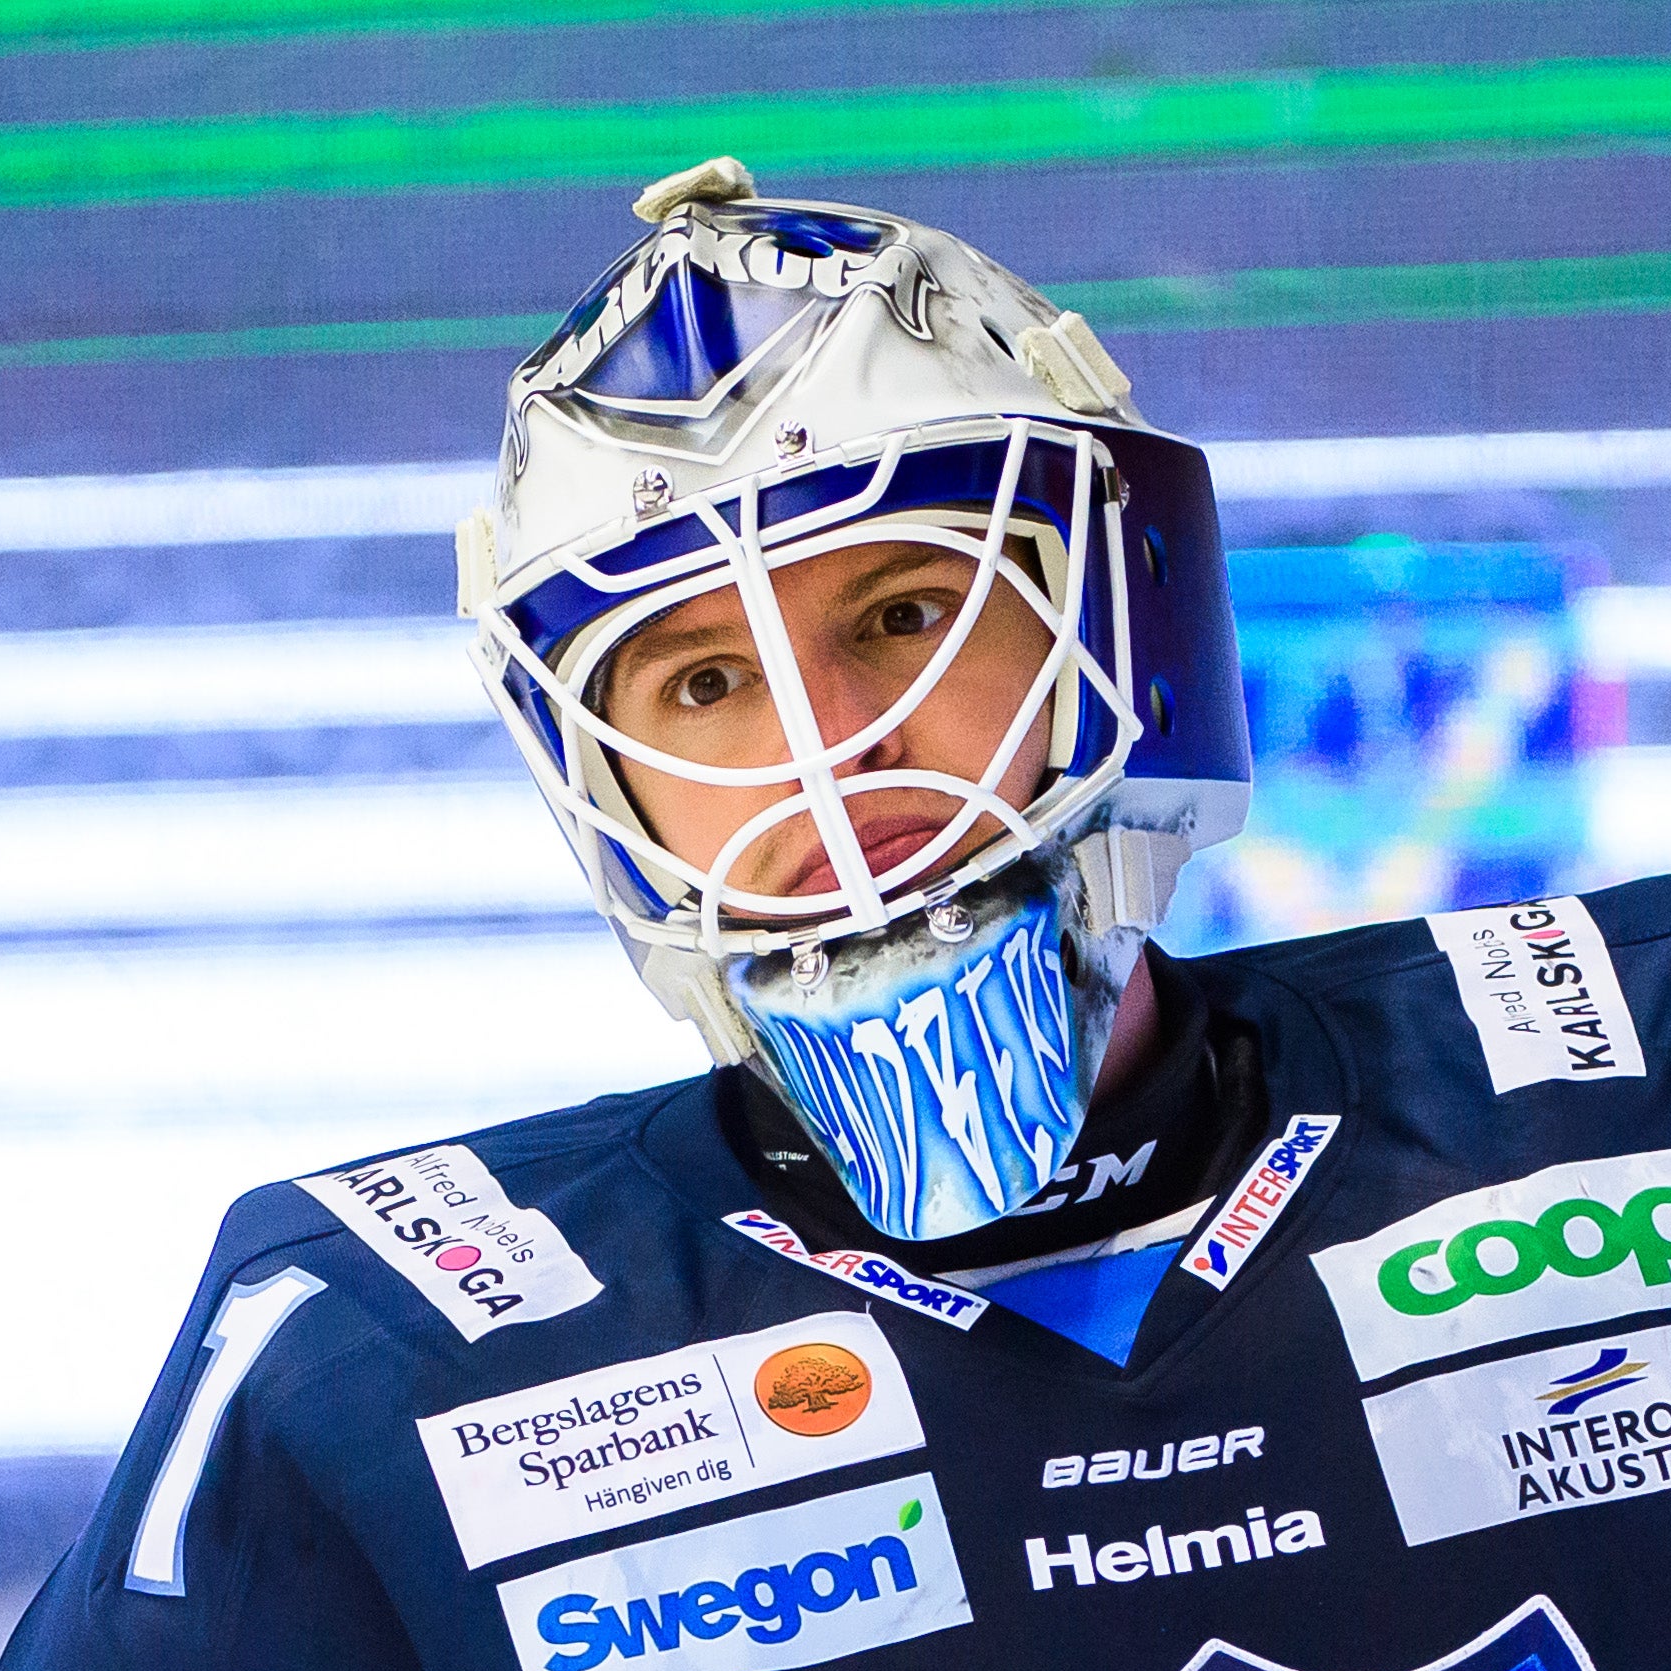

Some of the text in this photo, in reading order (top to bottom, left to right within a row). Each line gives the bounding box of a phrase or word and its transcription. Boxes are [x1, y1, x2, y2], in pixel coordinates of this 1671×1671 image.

[460, 1213, 535, 1264] Nbels
[760, 1231, 975, 1318] INERSPORT
[125, 1266, 329, 1598] 1
[451, 1372, 703, 1459] Bergslagens
[518, 1408, 720, 1490] Sparbank
[1042, 1426, 1266, 1489] BAUER
[584, 1455, 733, 1513] Hängiven dig
[1025, 1505, 1327, 1591] Helmia
